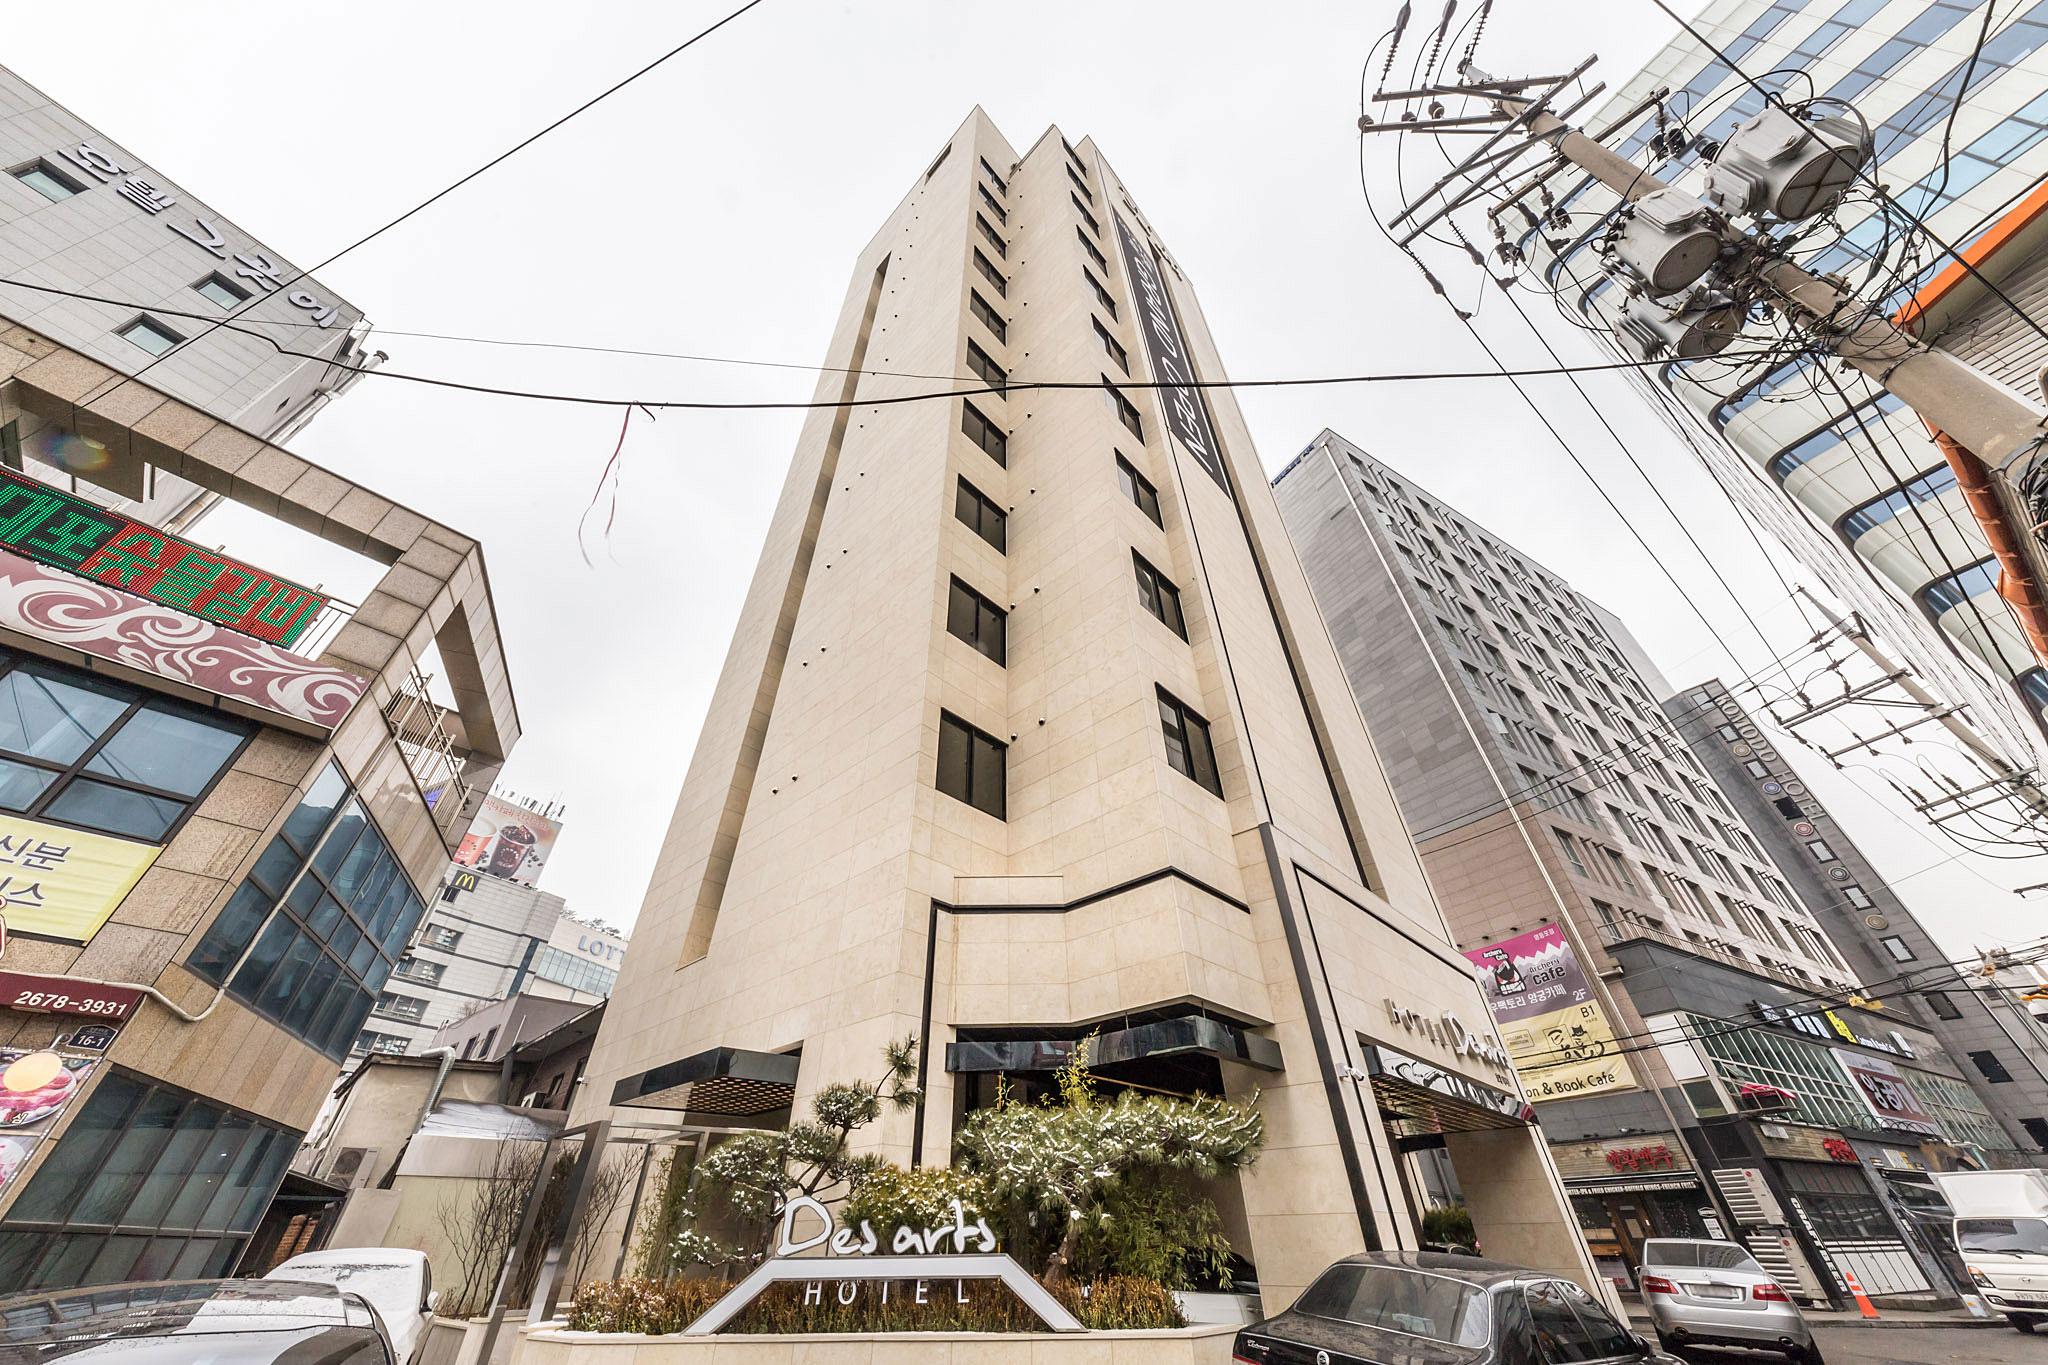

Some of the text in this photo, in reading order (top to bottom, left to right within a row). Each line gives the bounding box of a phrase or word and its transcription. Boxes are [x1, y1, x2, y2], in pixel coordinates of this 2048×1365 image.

[58, 142, 340, 329] 호텔 그곳에
[1134, 256, 1178, 358] GRAND
[1162, 357, 1213, 474] OPEN
[89, 533, 321, 647] 숯불갈비
[1714, 694, 1827, 823] KOMODO HOTEL
[13, 991, 128, 1016] 2678-3931
[1528, 984, 1567, 1005] 양궁카페
[1572, 988, 1588, 1002] 2F
[1580, 1004, 1596, 1019] B1
[77, 1035, 105, 1047] 16-1
[1542, 1082, 1554, 1096] &
[1555, 1077, 1587, 1093] Book
[1587, 1071, 1616, 1087] Cafe
[776, 1195, 997, 1257] Des arts
[803, 1278, 970, 1306] HOTEL
